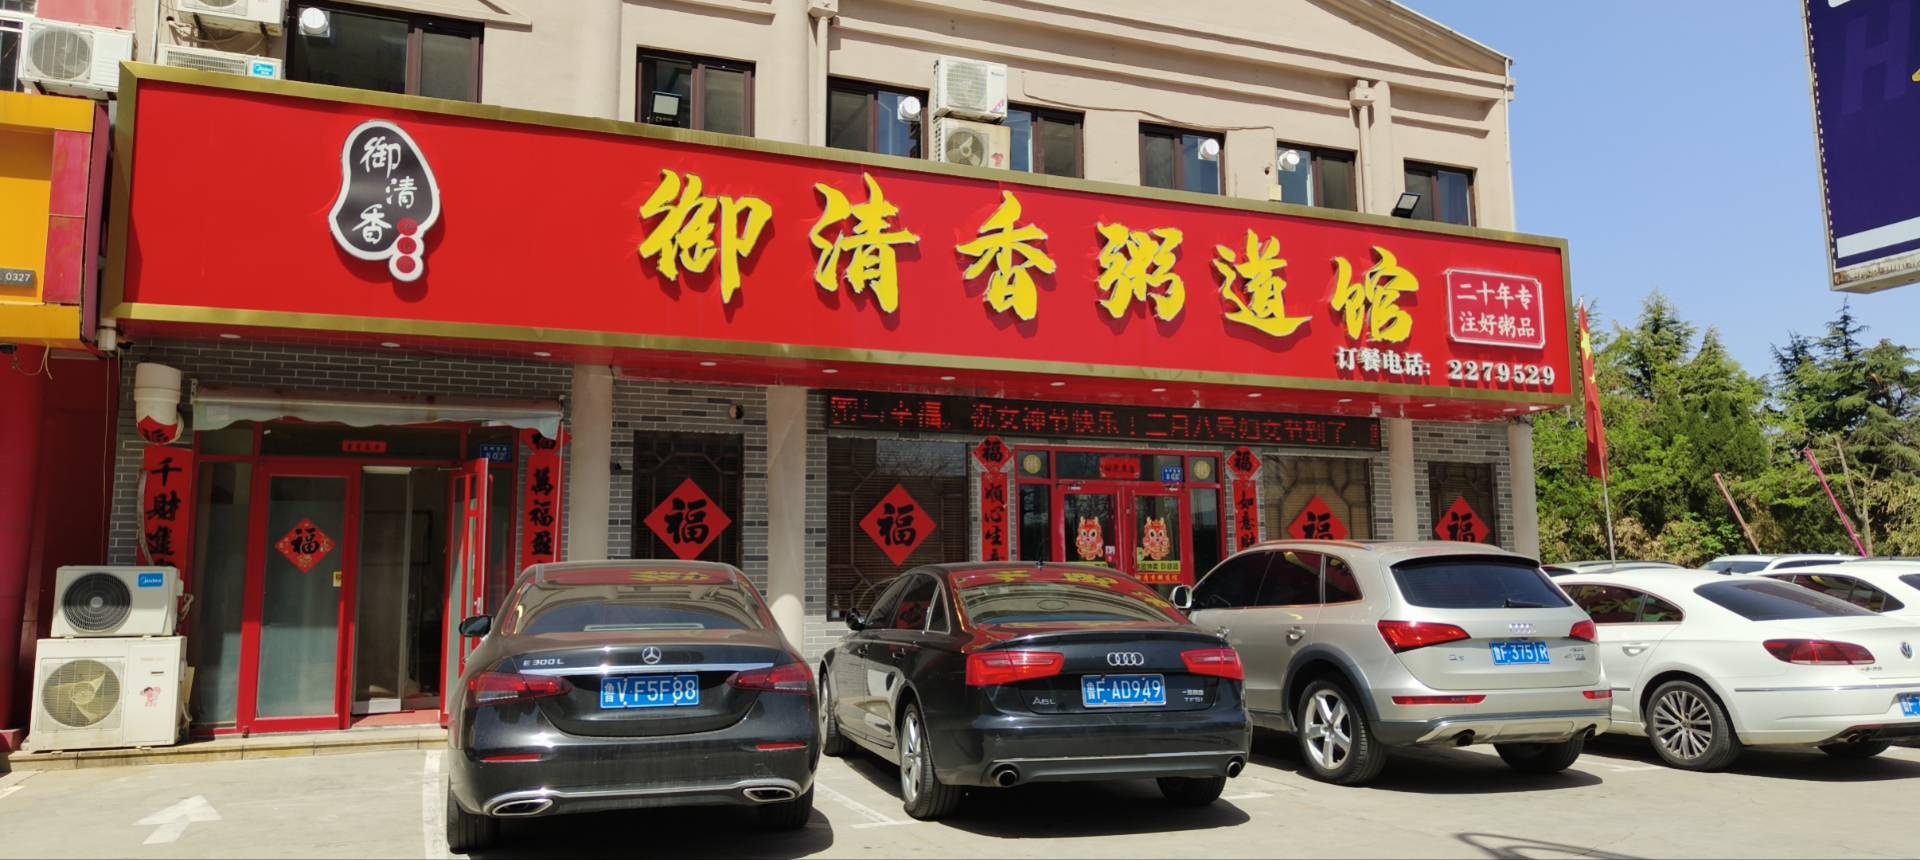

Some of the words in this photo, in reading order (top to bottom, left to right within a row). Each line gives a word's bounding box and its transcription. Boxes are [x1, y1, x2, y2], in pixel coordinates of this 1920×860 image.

[360, 136, 418, 245] 御清香
[5, 272, 31, 282] 0327
[639, 168, 1420, 344] 御清香粥道馆
[1456, 281, 1533, 310] 二十年专
[1459, 312, 1535, 338] 注好粥品
[1449, 359, 1555, 386] 2279529
[147, 457, 183, 566] 千財進
[529, 466, 554, 563] 萬福盈
[664, 498, 709, 544] 福
[877, 503, 916, 546] 福
[291, 528, 320, 554] 福
